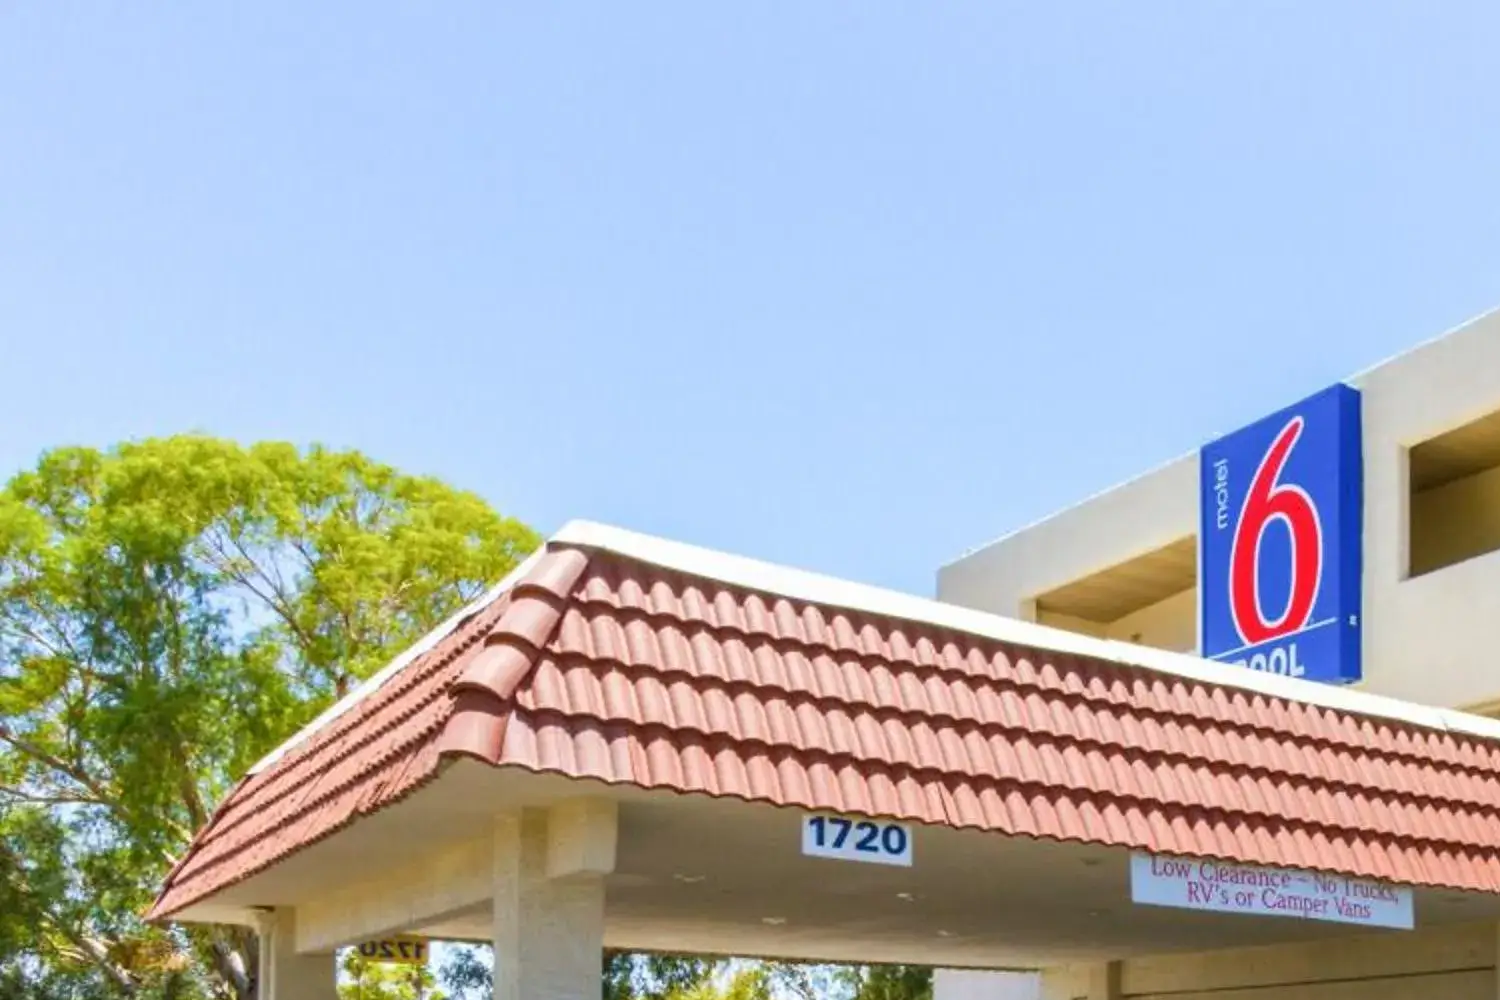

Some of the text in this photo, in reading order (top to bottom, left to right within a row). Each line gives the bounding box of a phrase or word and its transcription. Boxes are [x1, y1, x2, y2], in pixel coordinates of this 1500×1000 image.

[1213, 458, 1229, 529] motel
[1229, 415, 1323, 646] 6
[1234, 643, 1305, 677] OOL
[808, 815, 907, 855] 1720
[1151, 854, 1191, 878] Low
[1199, 860, 1291, 889] Clearance
[1313, 873, 1338, 895] No
[1344, 878, 1399, 906] Trucks,
[1187, 880, 1371, 919] RV's or Camper Vans
